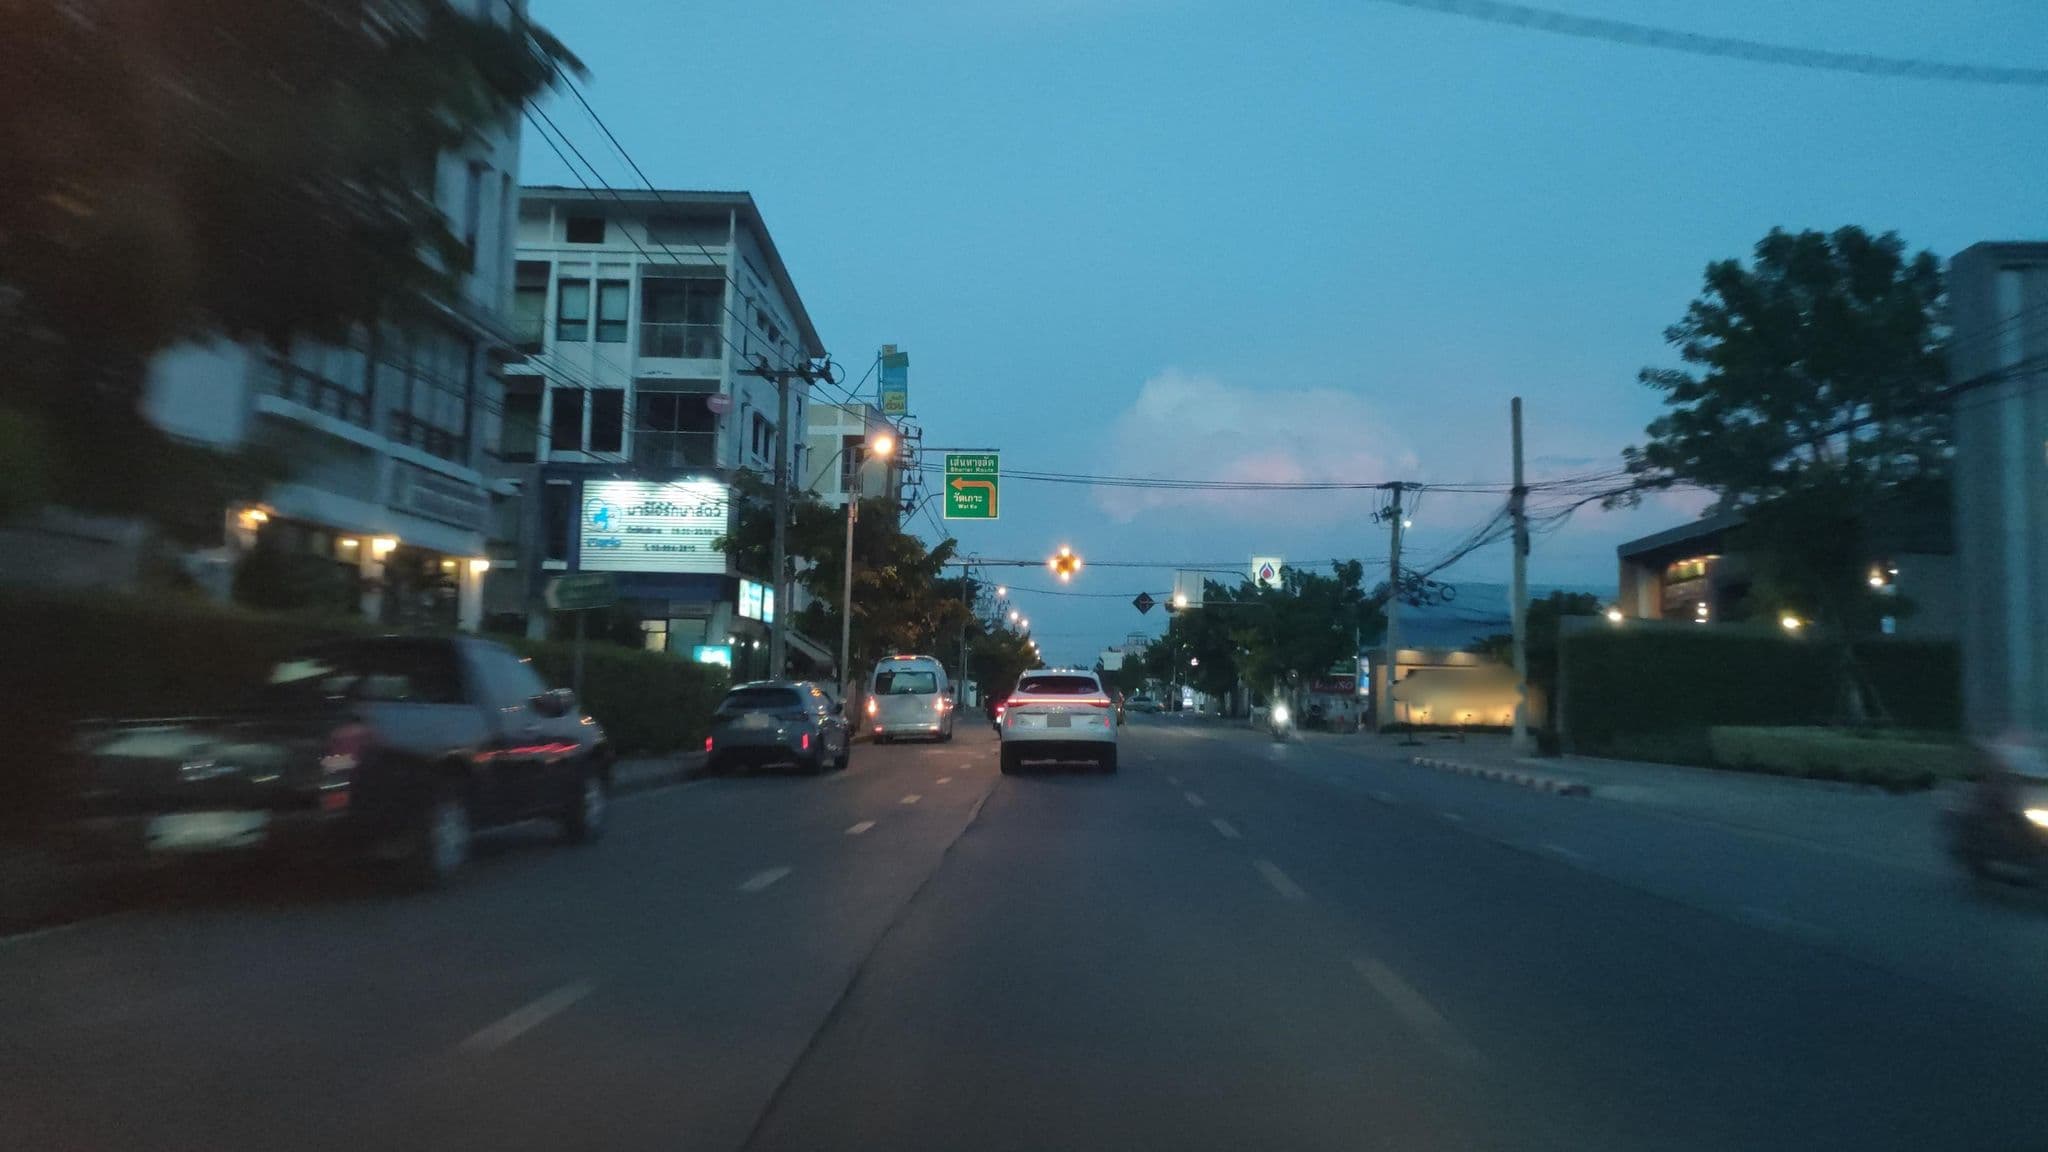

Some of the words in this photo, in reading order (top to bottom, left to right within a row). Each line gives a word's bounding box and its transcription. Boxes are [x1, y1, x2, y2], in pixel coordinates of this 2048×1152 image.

[951, 456, 994, 467] เส้นทางลัด
[953, 491, 983, 502] วัดเกาะ
